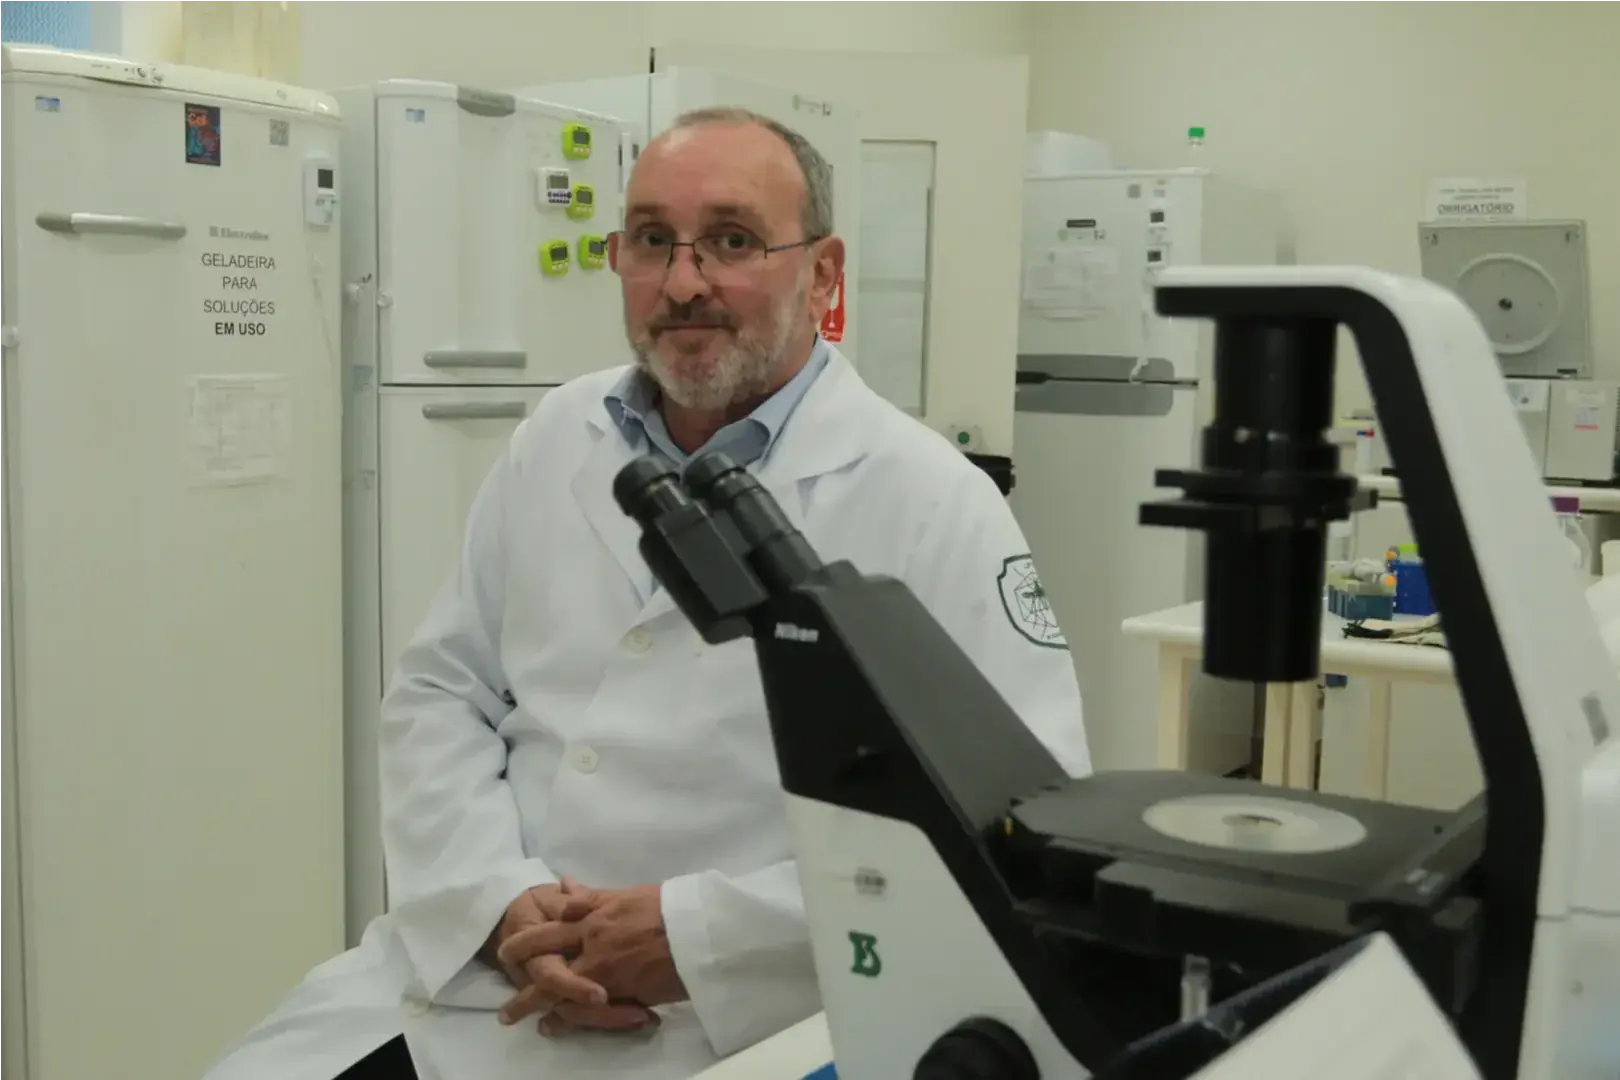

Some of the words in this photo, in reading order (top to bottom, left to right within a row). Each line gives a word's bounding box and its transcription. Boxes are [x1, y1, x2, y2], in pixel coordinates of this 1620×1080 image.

[201, 252, 276, 270] GELADEIRA
[222, 276, 258, 290] PARA
[203, 299, 275, 317] SOLUÇÕES
[215, 322, 235, 335] EM
[238, 322, 266, 336] USO
